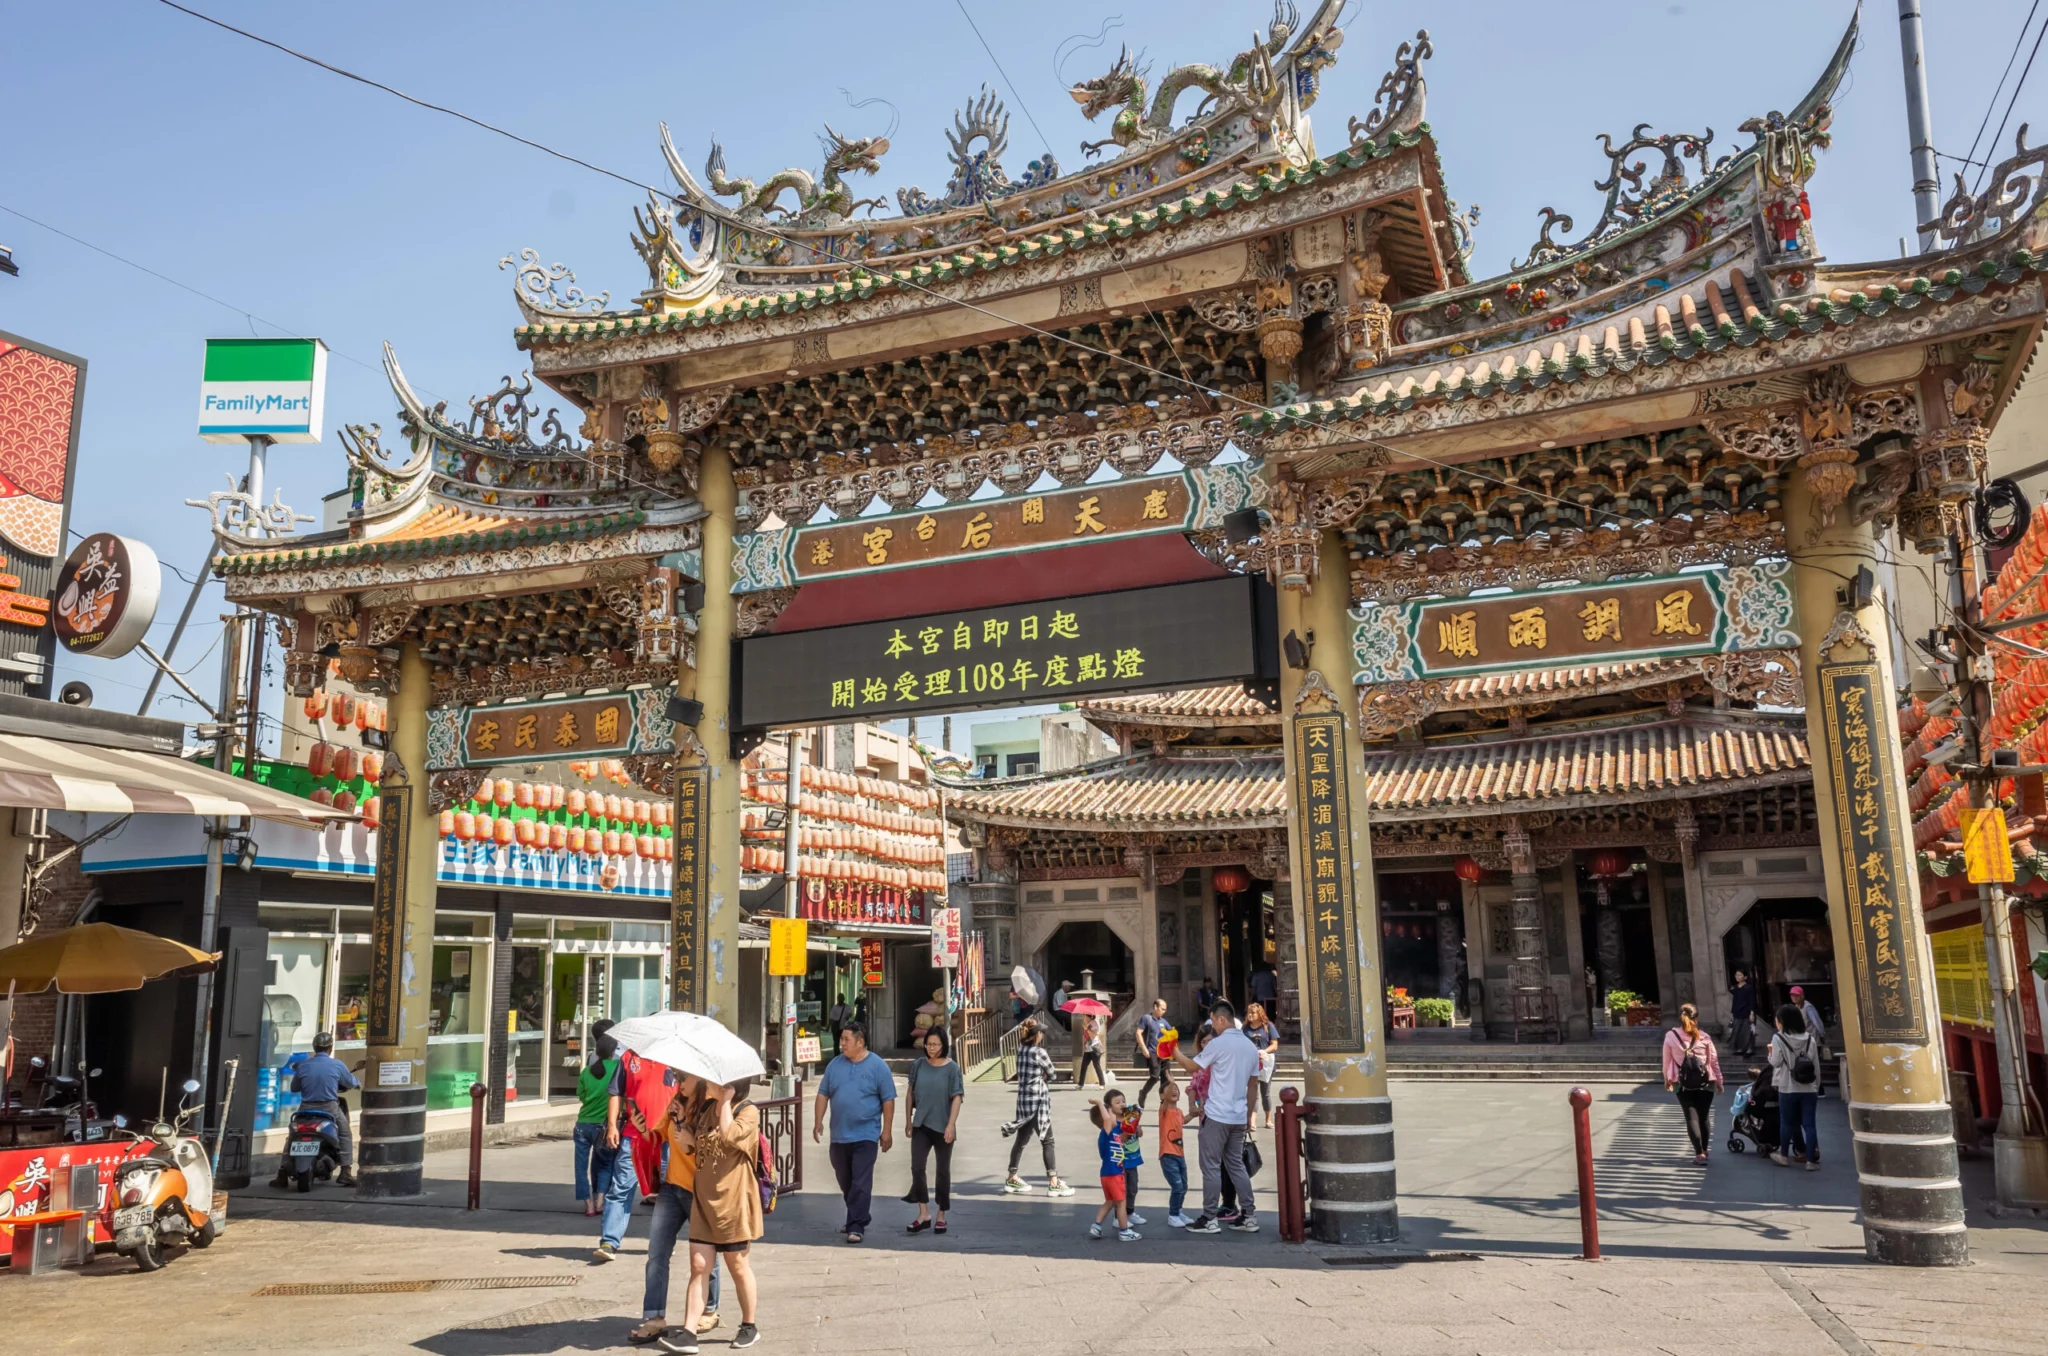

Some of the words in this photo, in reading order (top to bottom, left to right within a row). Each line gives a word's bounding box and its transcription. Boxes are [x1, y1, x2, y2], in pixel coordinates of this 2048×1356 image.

[205, 394, 309, 415] FamilyMart
[884, 609, 1080, 660] 本宮自即日起
[830, 647, 1146, 709] 開始受理108年度點燈
[509, 845, 603, 879] FamilyMart
[946, 909, 960, 954] 化粧室
